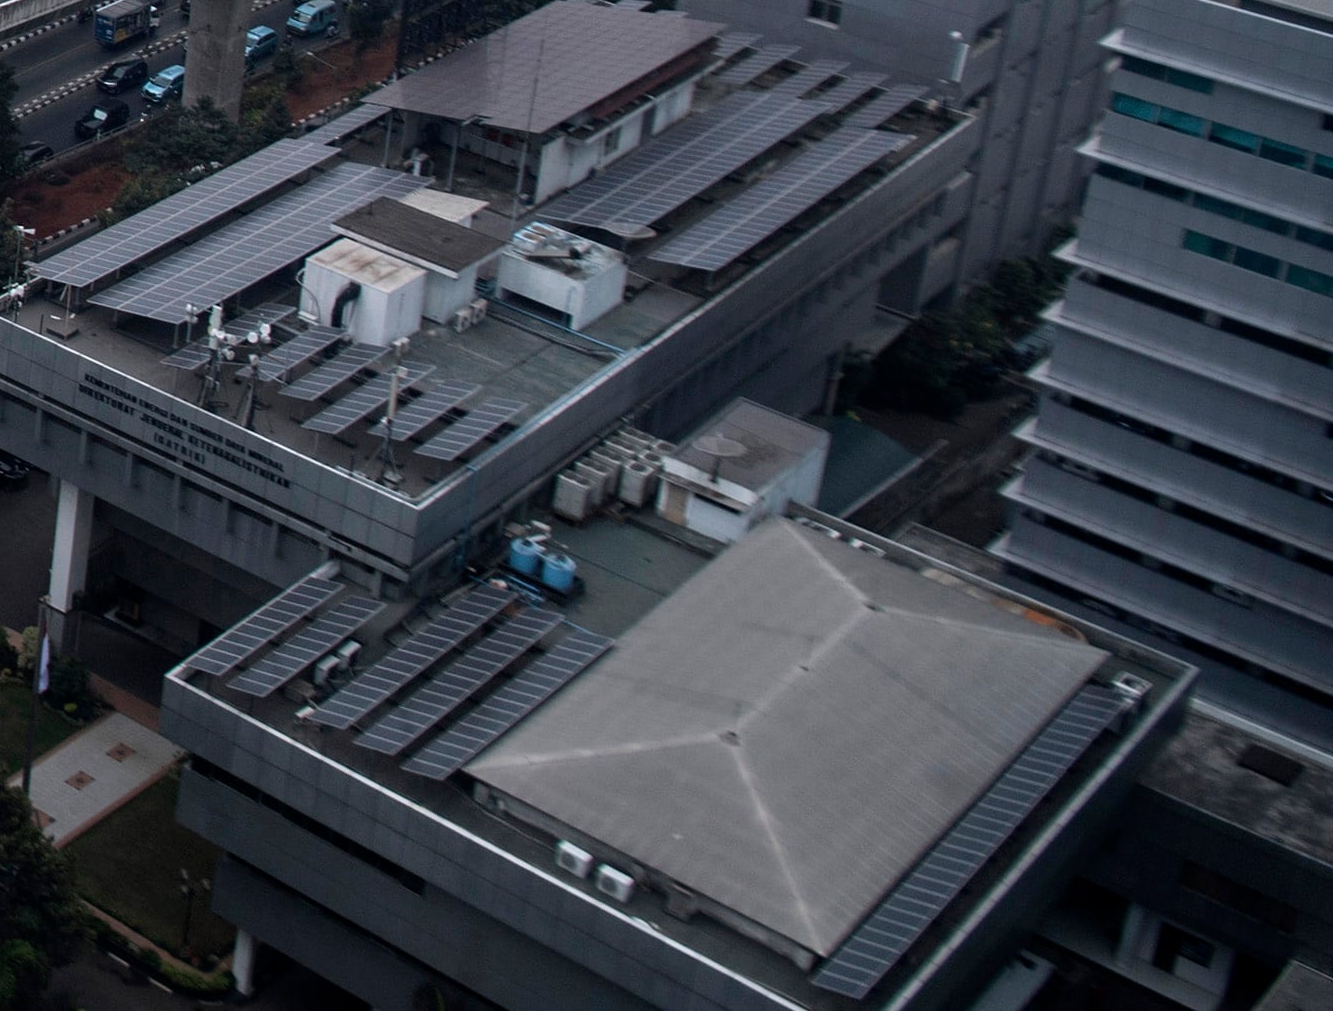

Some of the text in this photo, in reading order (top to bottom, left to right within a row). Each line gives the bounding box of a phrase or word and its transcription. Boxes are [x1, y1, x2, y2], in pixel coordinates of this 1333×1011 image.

[78, 384, 135, 416] DIREKTORAT
[139, 413, 185, 440] JENDERAL
[84, 374, 137, 403] KEMENTERIAN
[169, 414, 188, 427] DAN
[189, 423, 223, 442] SUMBER
[224, 438, 245, 454] DAYA
[248, 449, 285, 473] MINERAL
